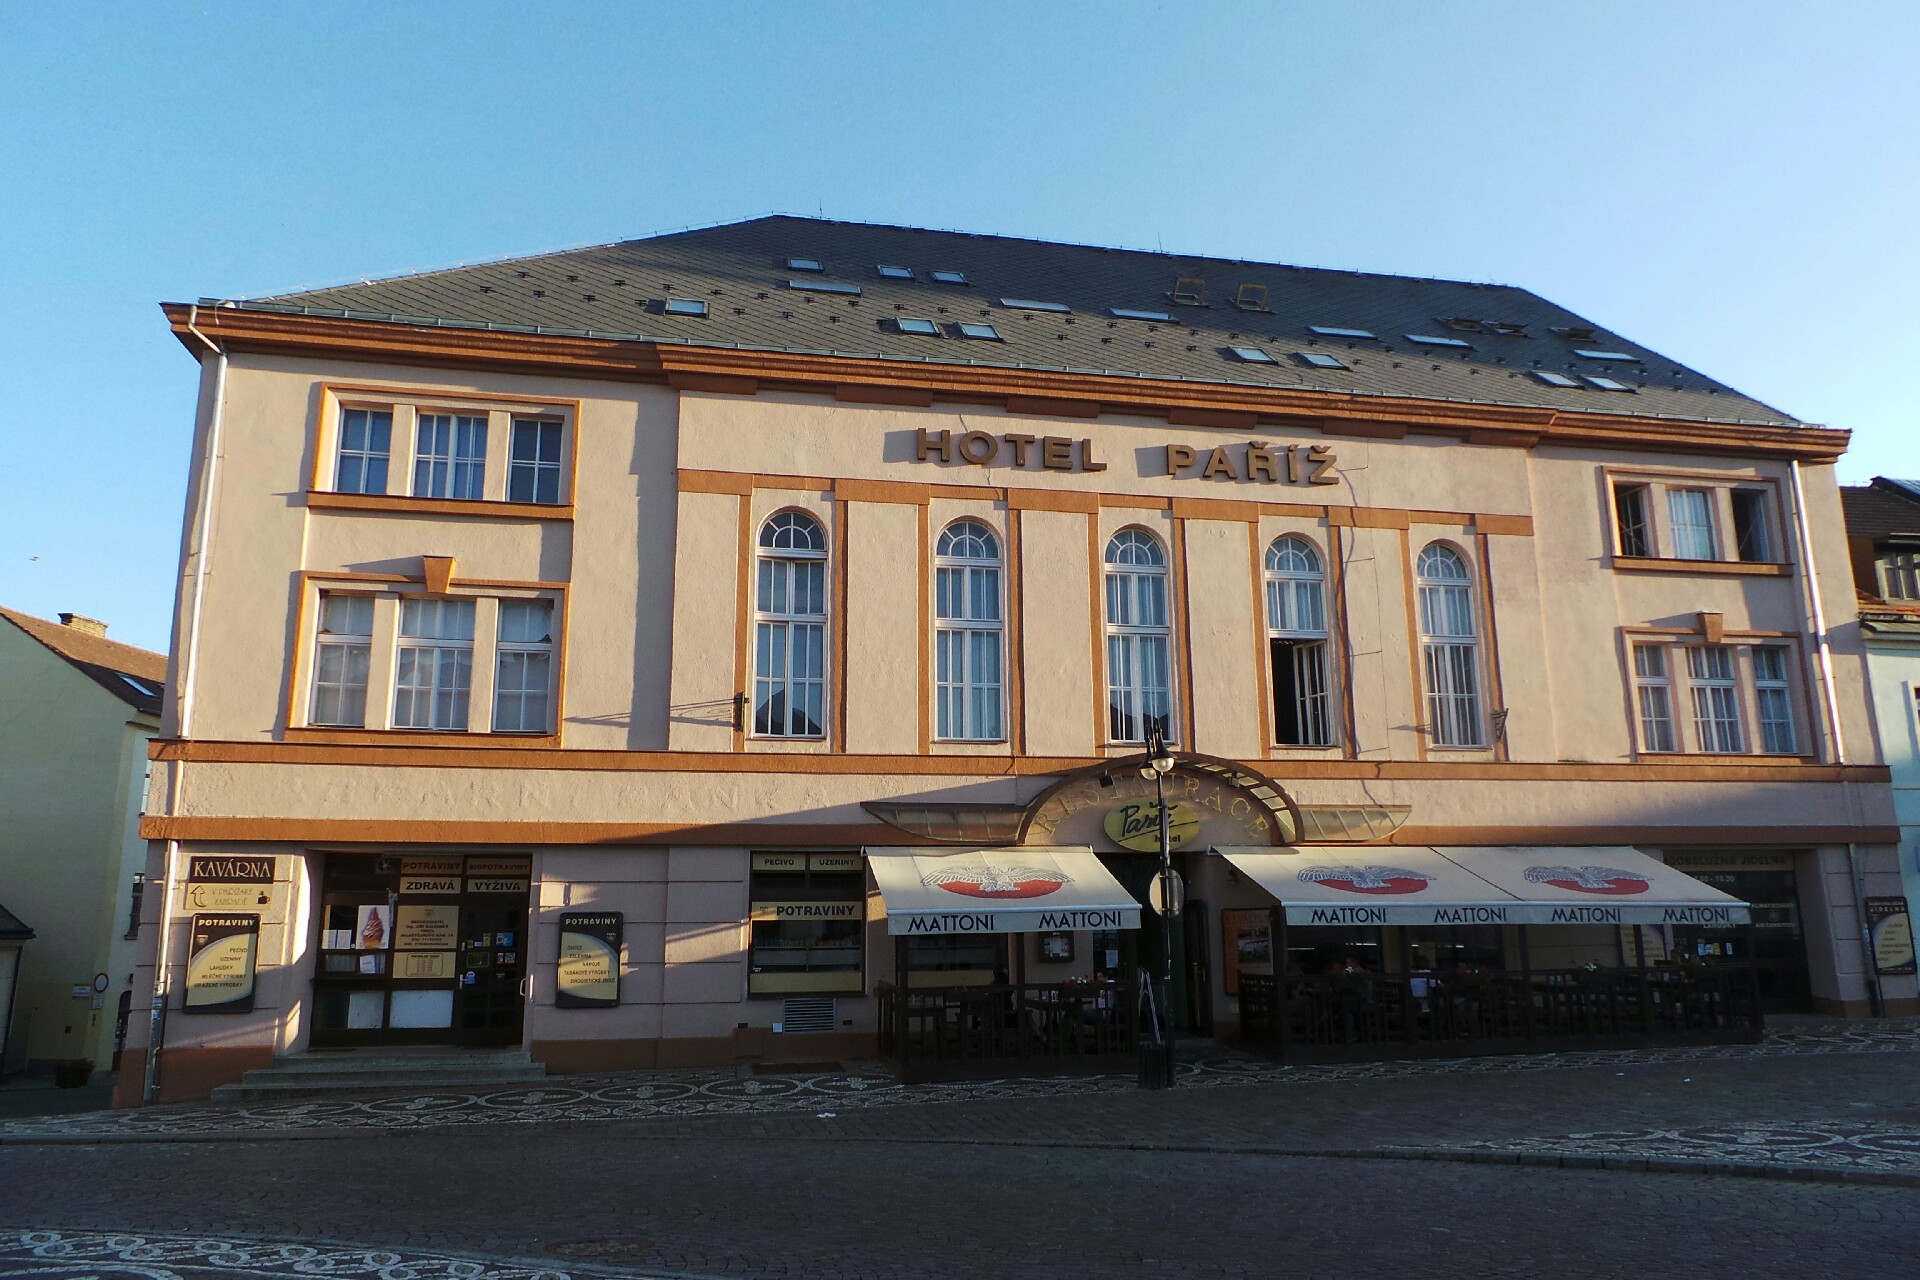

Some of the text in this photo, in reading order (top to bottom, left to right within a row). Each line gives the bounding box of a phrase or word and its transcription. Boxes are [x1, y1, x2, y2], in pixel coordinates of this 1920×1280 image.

[916, 427, 1341, 485] HOTEL PAŘÍŽ
[1154, 834, 1181, 843] htel
[403, 862, 462, 871] POTRAVINY
[468, 863, 528, 871] BIOPOTRAVINY
[764, 857, 795, 866] PEČIVO
[819, 858, 855, 866] UZENINY
[193, 858, 271, 878] KAVÁRNA
[405, 879, 455, 891] ZDRAVÁ
[474, 880, 521, 891] VÝŽIVA
[776, 904, 855, 916] POTRAVINY
[1310, 907, 1387, 924] MATTONI
[1433, 907, 1507, 924] MATTONI
[1550, 907, 1621, 924] MATTONI
[1662, 907, 1730, 923] MATTONI
[197, 919, 256, 927] POTRAVINY
[565, 918, 617, 926] POTRAVINY
[907, 914, 994, 933] MATTONI
[1038, 910, 1121, 929] MATTONI
[201, 972, 222, 980] MLÉČNÉ
